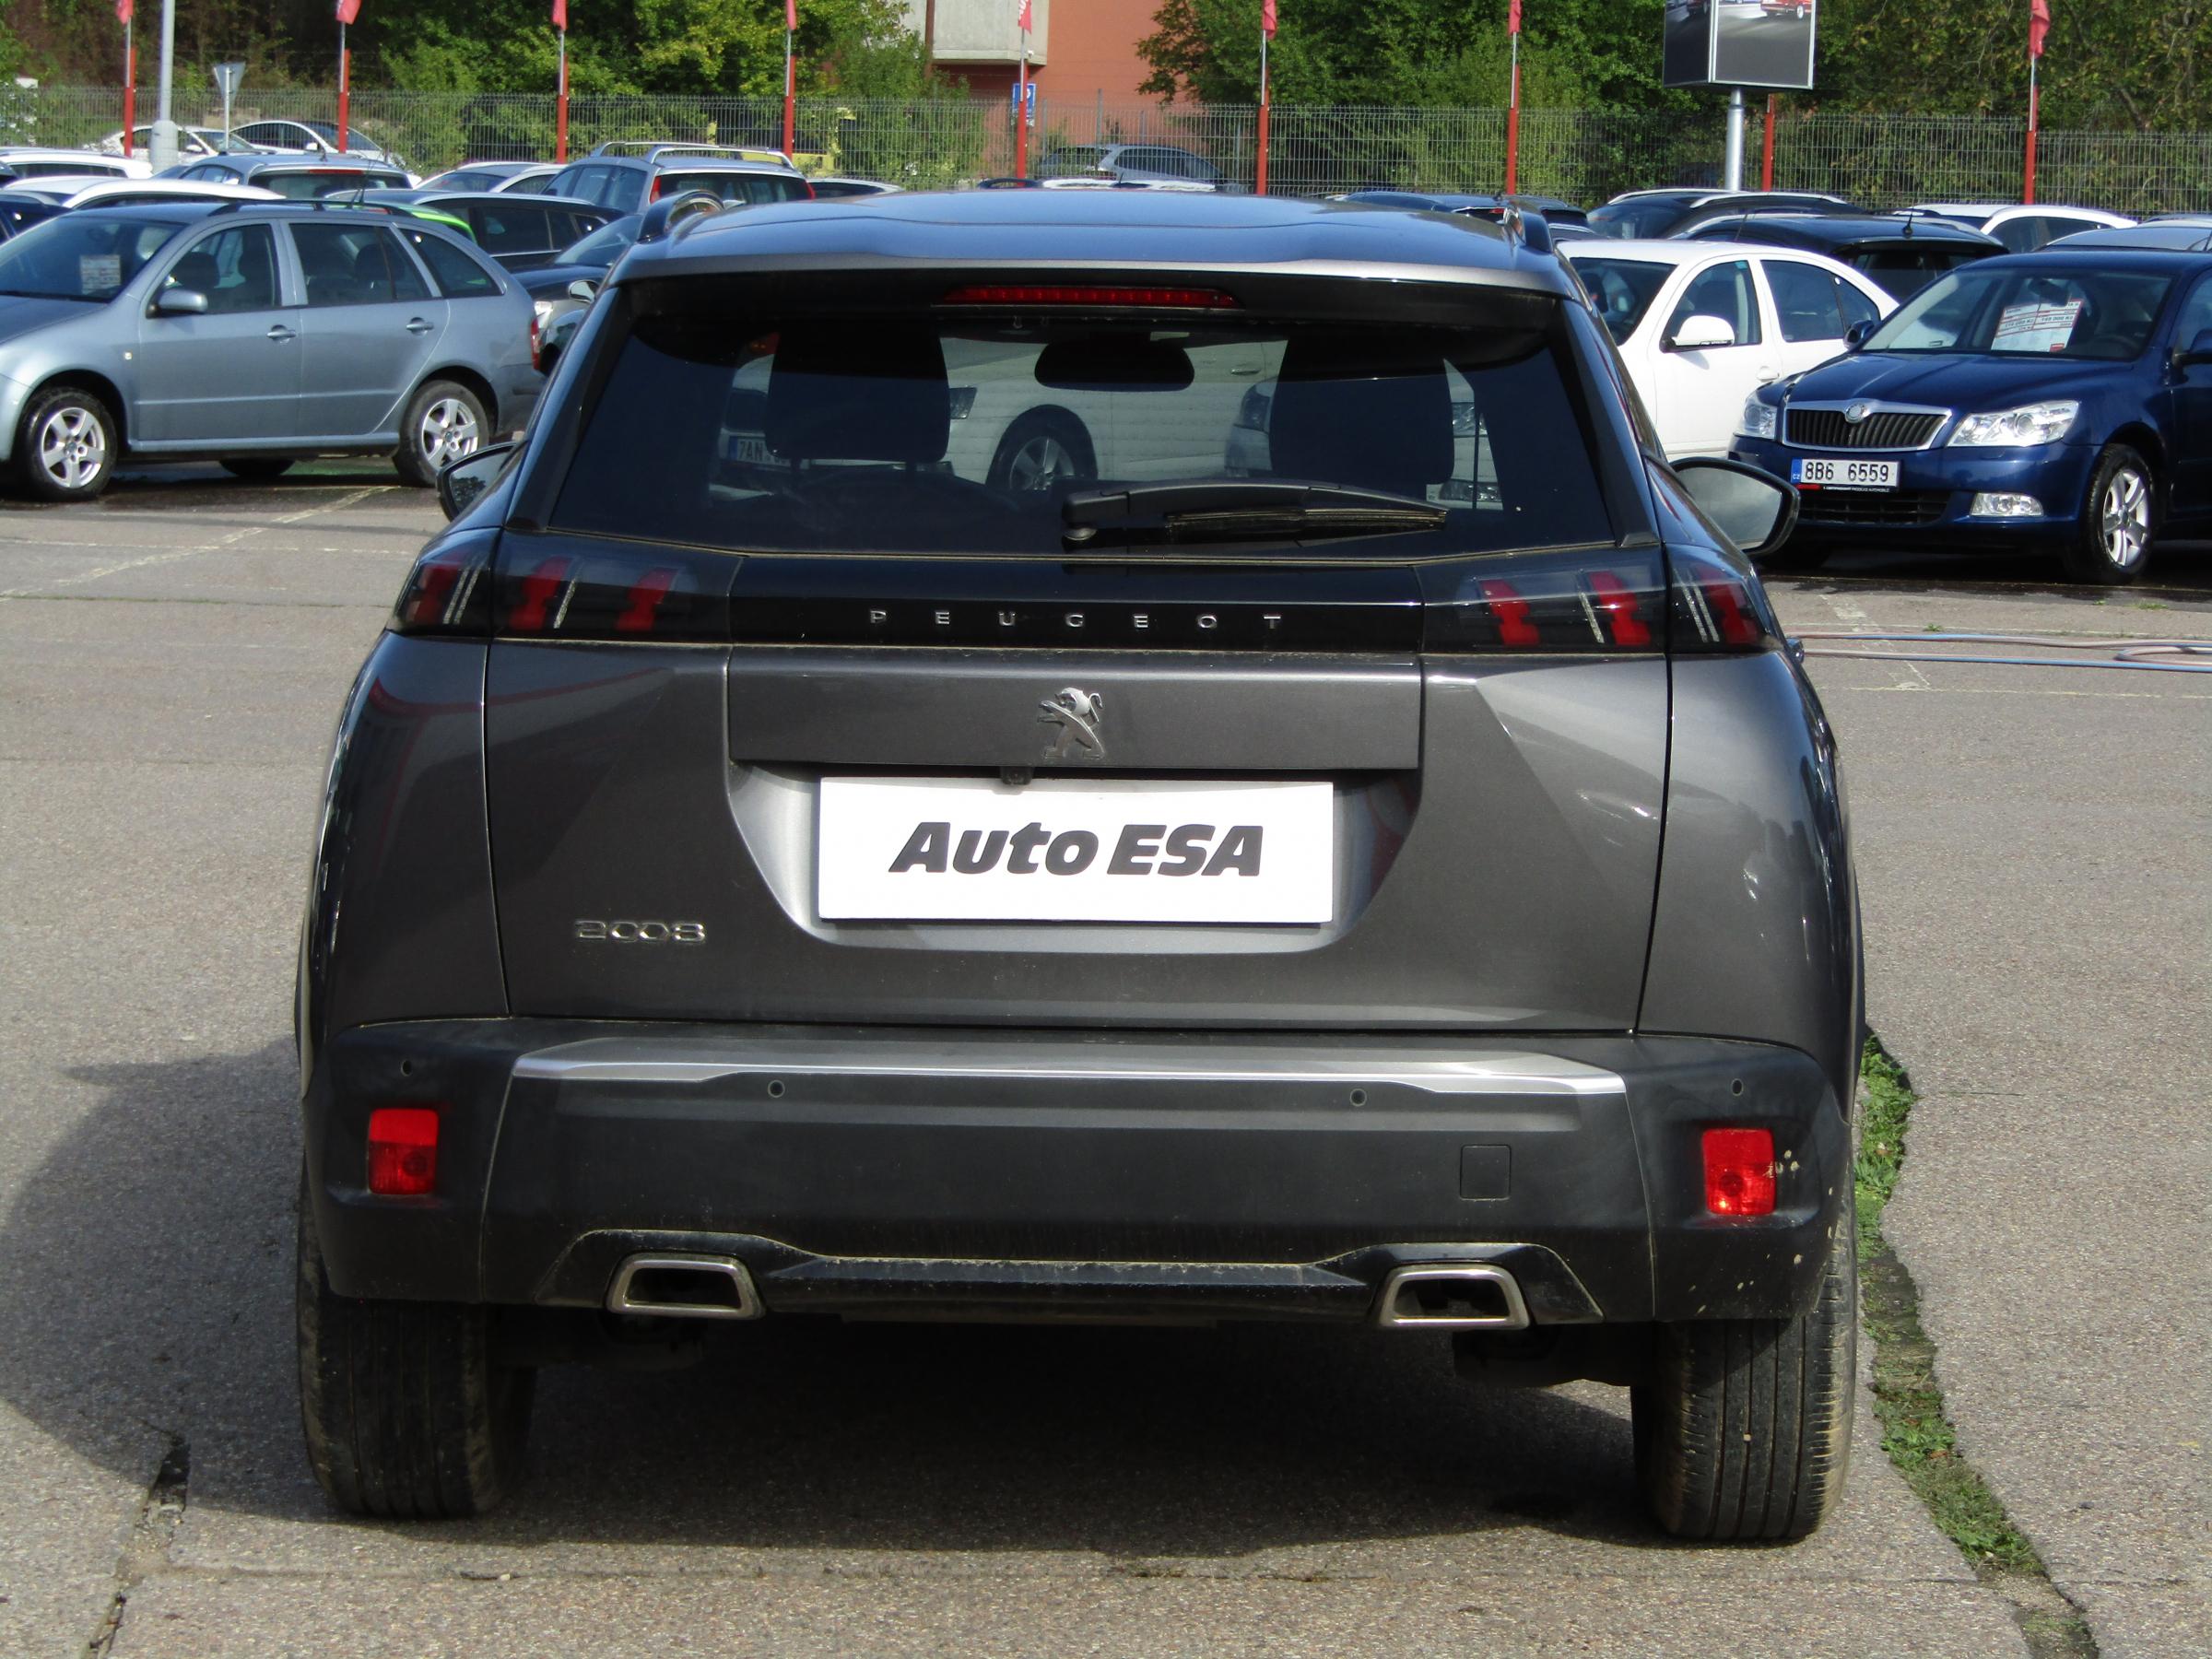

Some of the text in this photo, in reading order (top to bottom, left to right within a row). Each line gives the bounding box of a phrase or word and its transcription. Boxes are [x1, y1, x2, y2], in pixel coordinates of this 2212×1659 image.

[1806, 462, 1888, 482] 8B6 6559
[870, 609, 1282, 629] PEUGEOT
[888, 821, 1263, 877] Auto ESA
[575, 919, 706, 944] 2008
